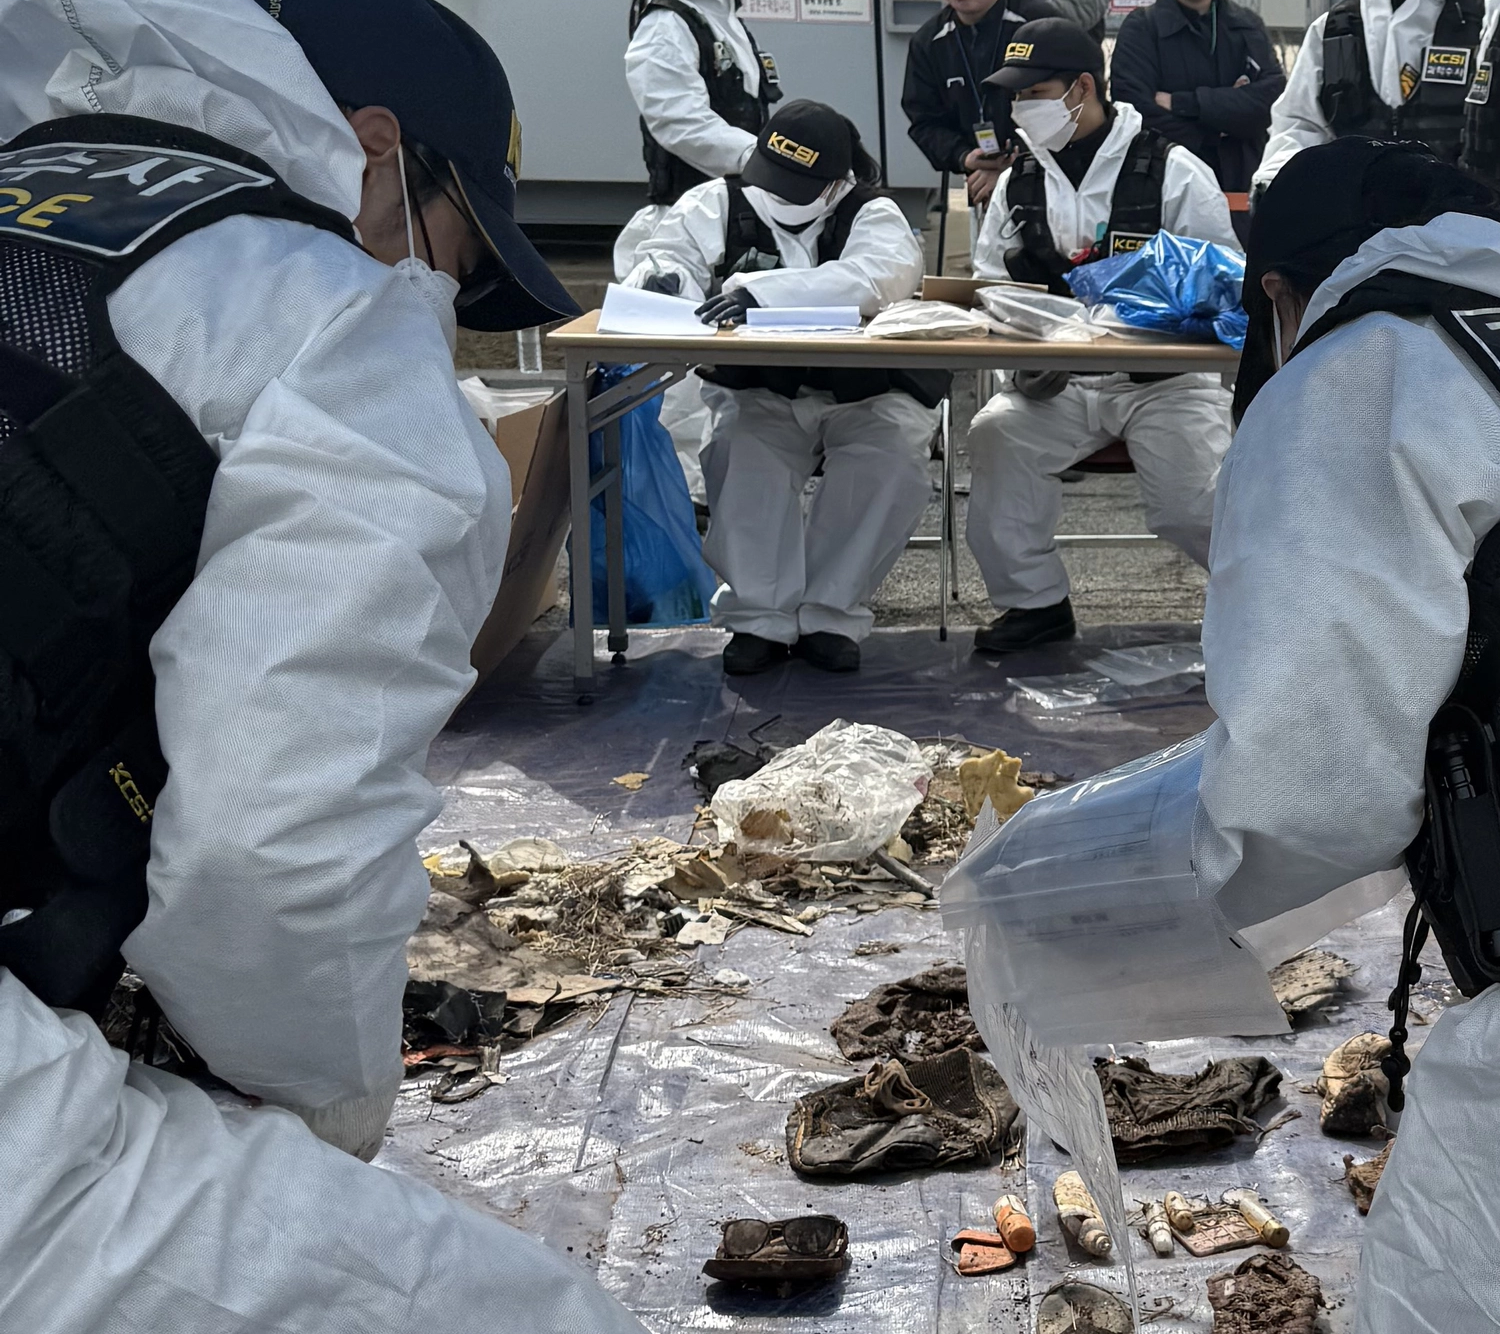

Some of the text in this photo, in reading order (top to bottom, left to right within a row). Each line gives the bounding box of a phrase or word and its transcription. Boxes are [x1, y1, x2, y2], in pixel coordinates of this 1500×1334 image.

[1005, 42, 1034, 58] CSI
[1429, 53, 1465, 65] KCSI
[767, 132, 819, 166] KCSI
[0, 151, 216, 197] 수사
